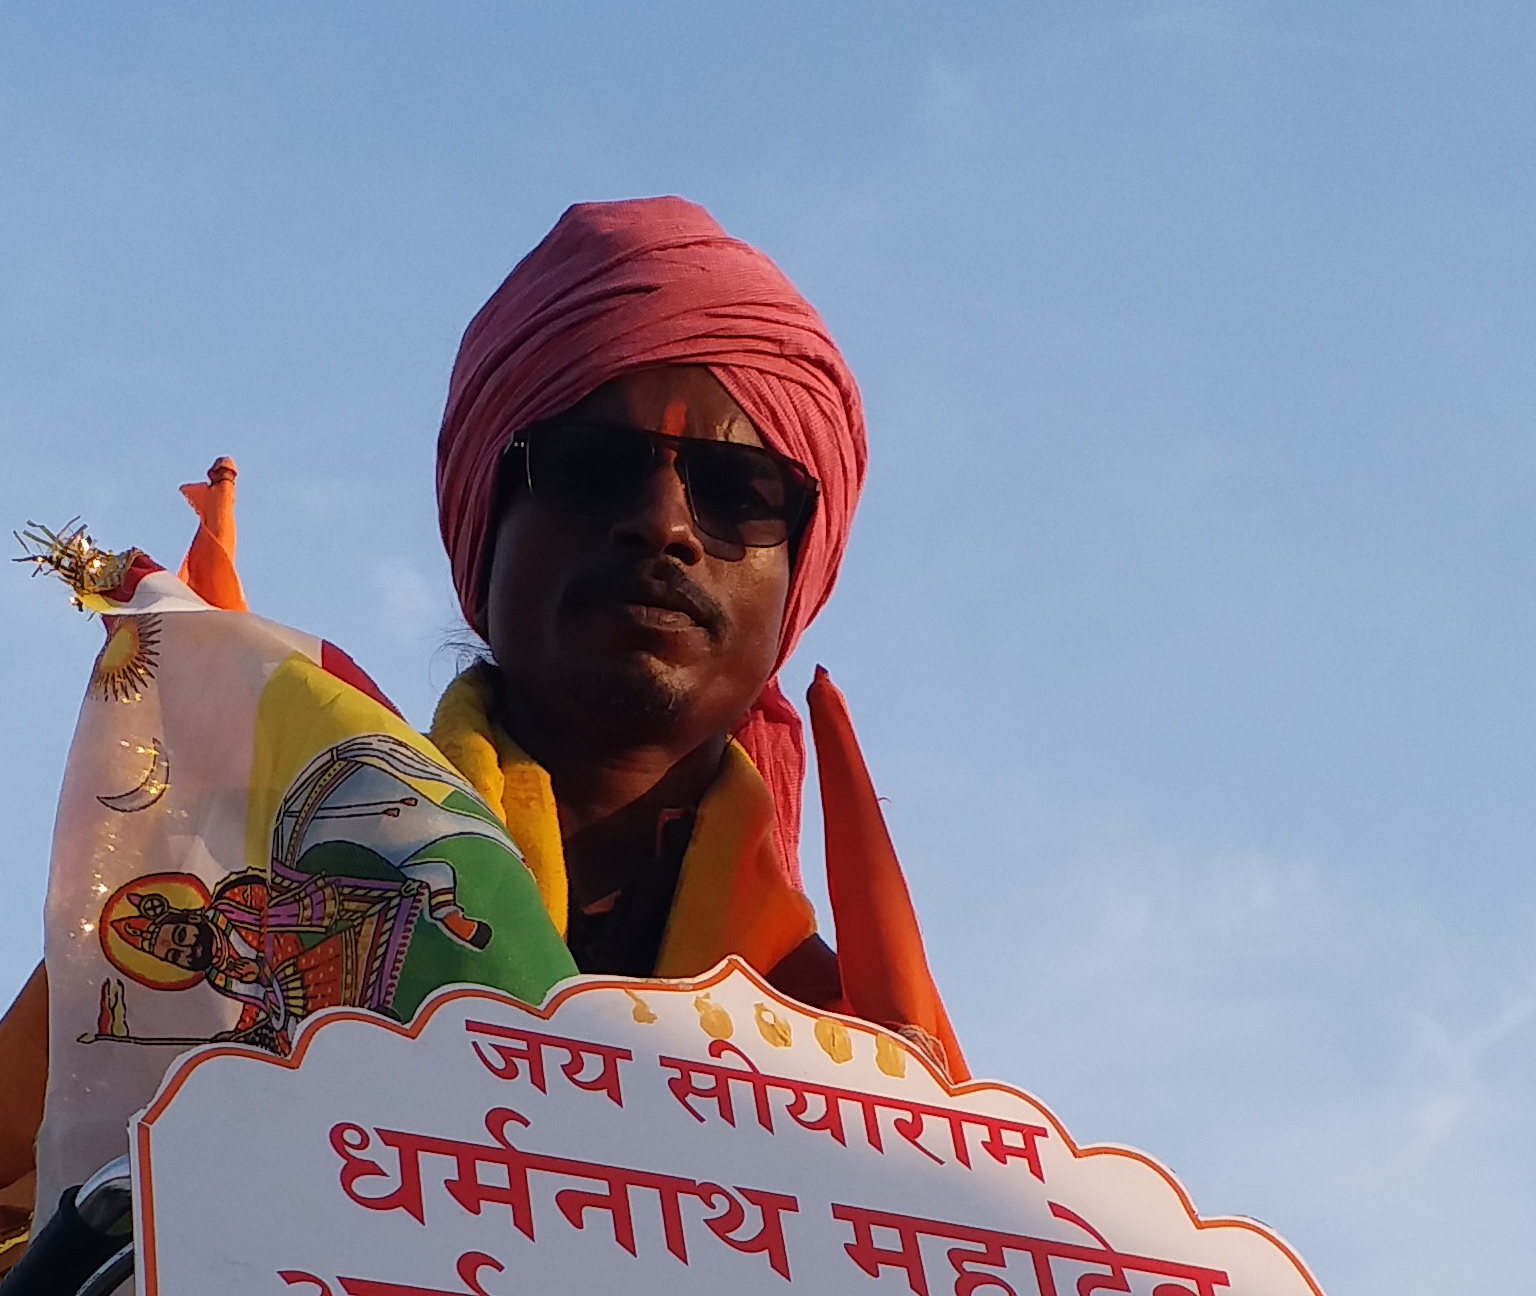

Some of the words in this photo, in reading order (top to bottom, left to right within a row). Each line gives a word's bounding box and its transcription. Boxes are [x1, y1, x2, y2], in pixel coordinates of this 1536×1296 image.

[465, 1021, 633, 1108] जय
[659, 1039, 1049, 1183] सीयाराम
[329, 1108, 799, 1281] धर्मनाथ
